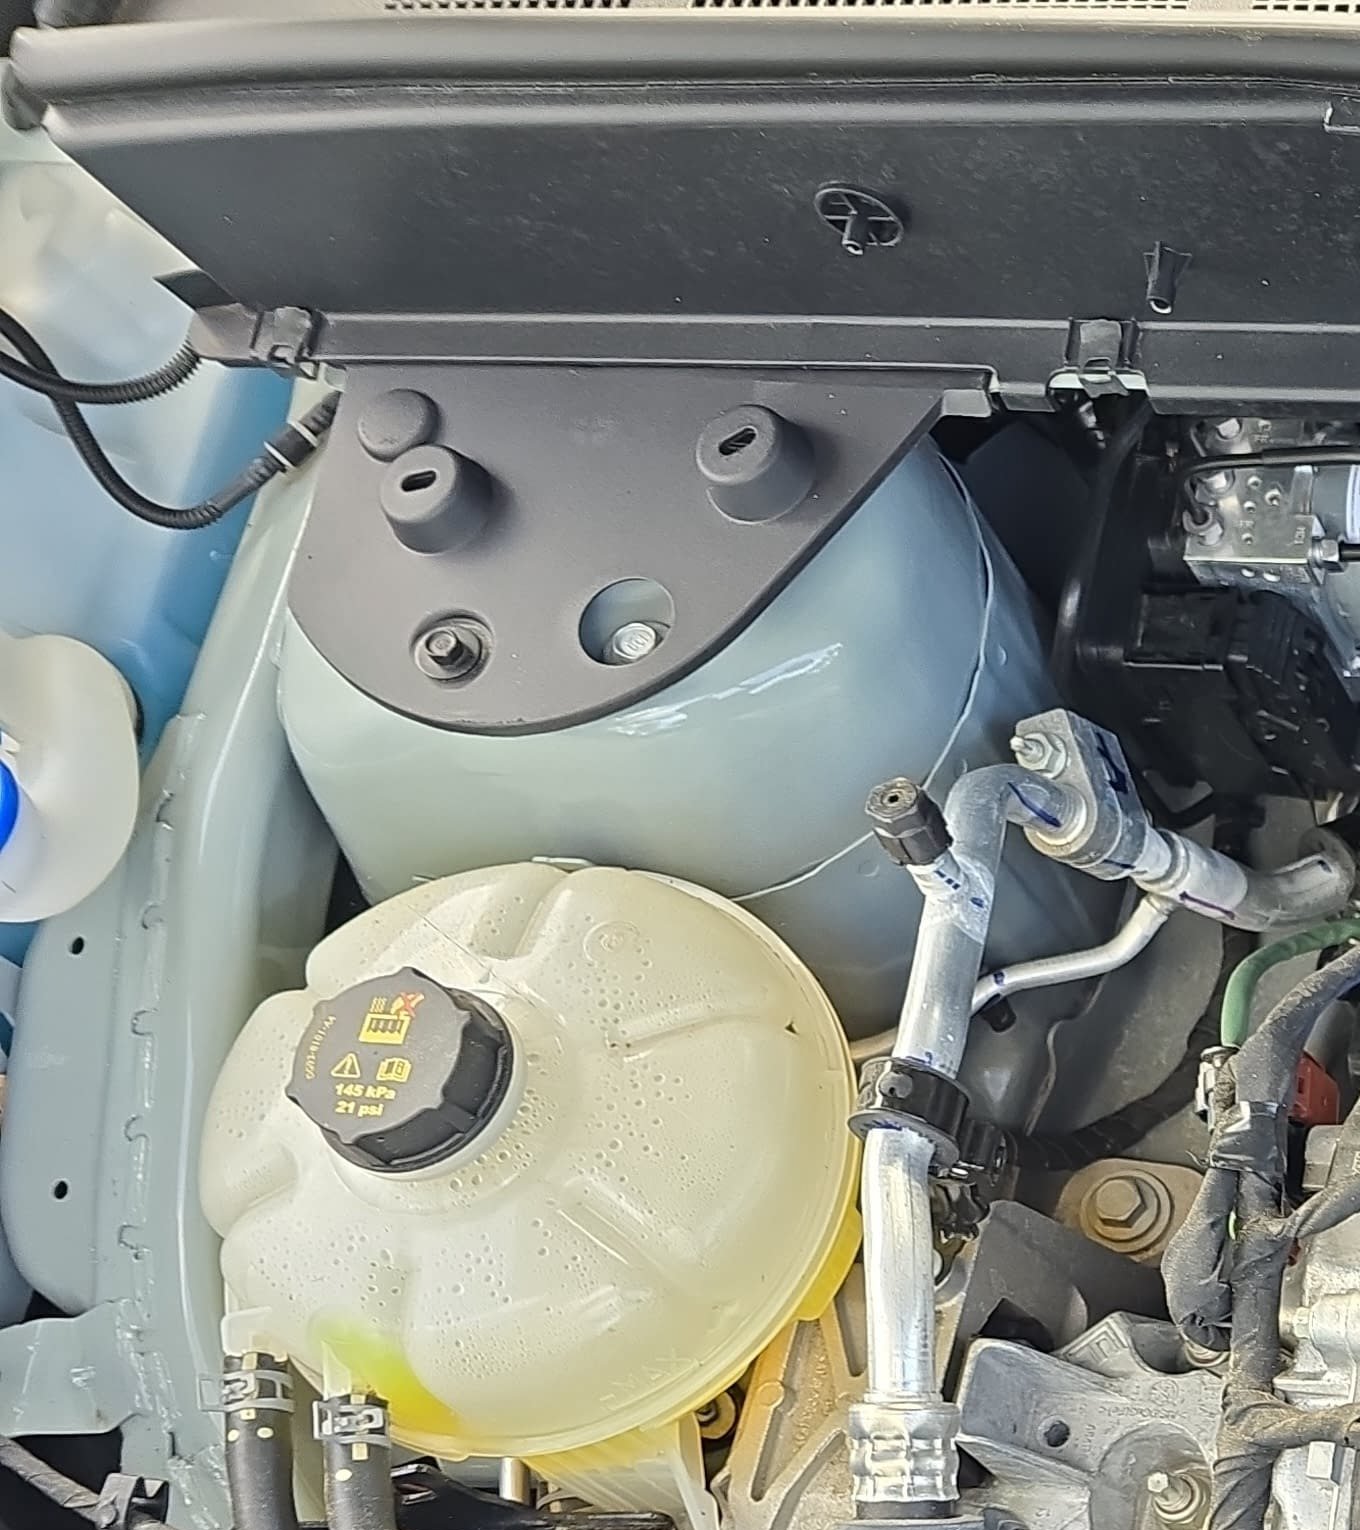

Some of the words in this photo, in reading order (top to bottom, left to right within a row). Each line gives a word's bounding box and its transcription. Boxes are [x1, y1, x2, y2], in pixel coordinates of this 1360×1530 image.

[335, 1083, 364, 1096] 145
[365, 1085, 396, 1100] kPa
[335, 1100, 356, 1113] 21
[358, 1103, 384, 1117] psi
